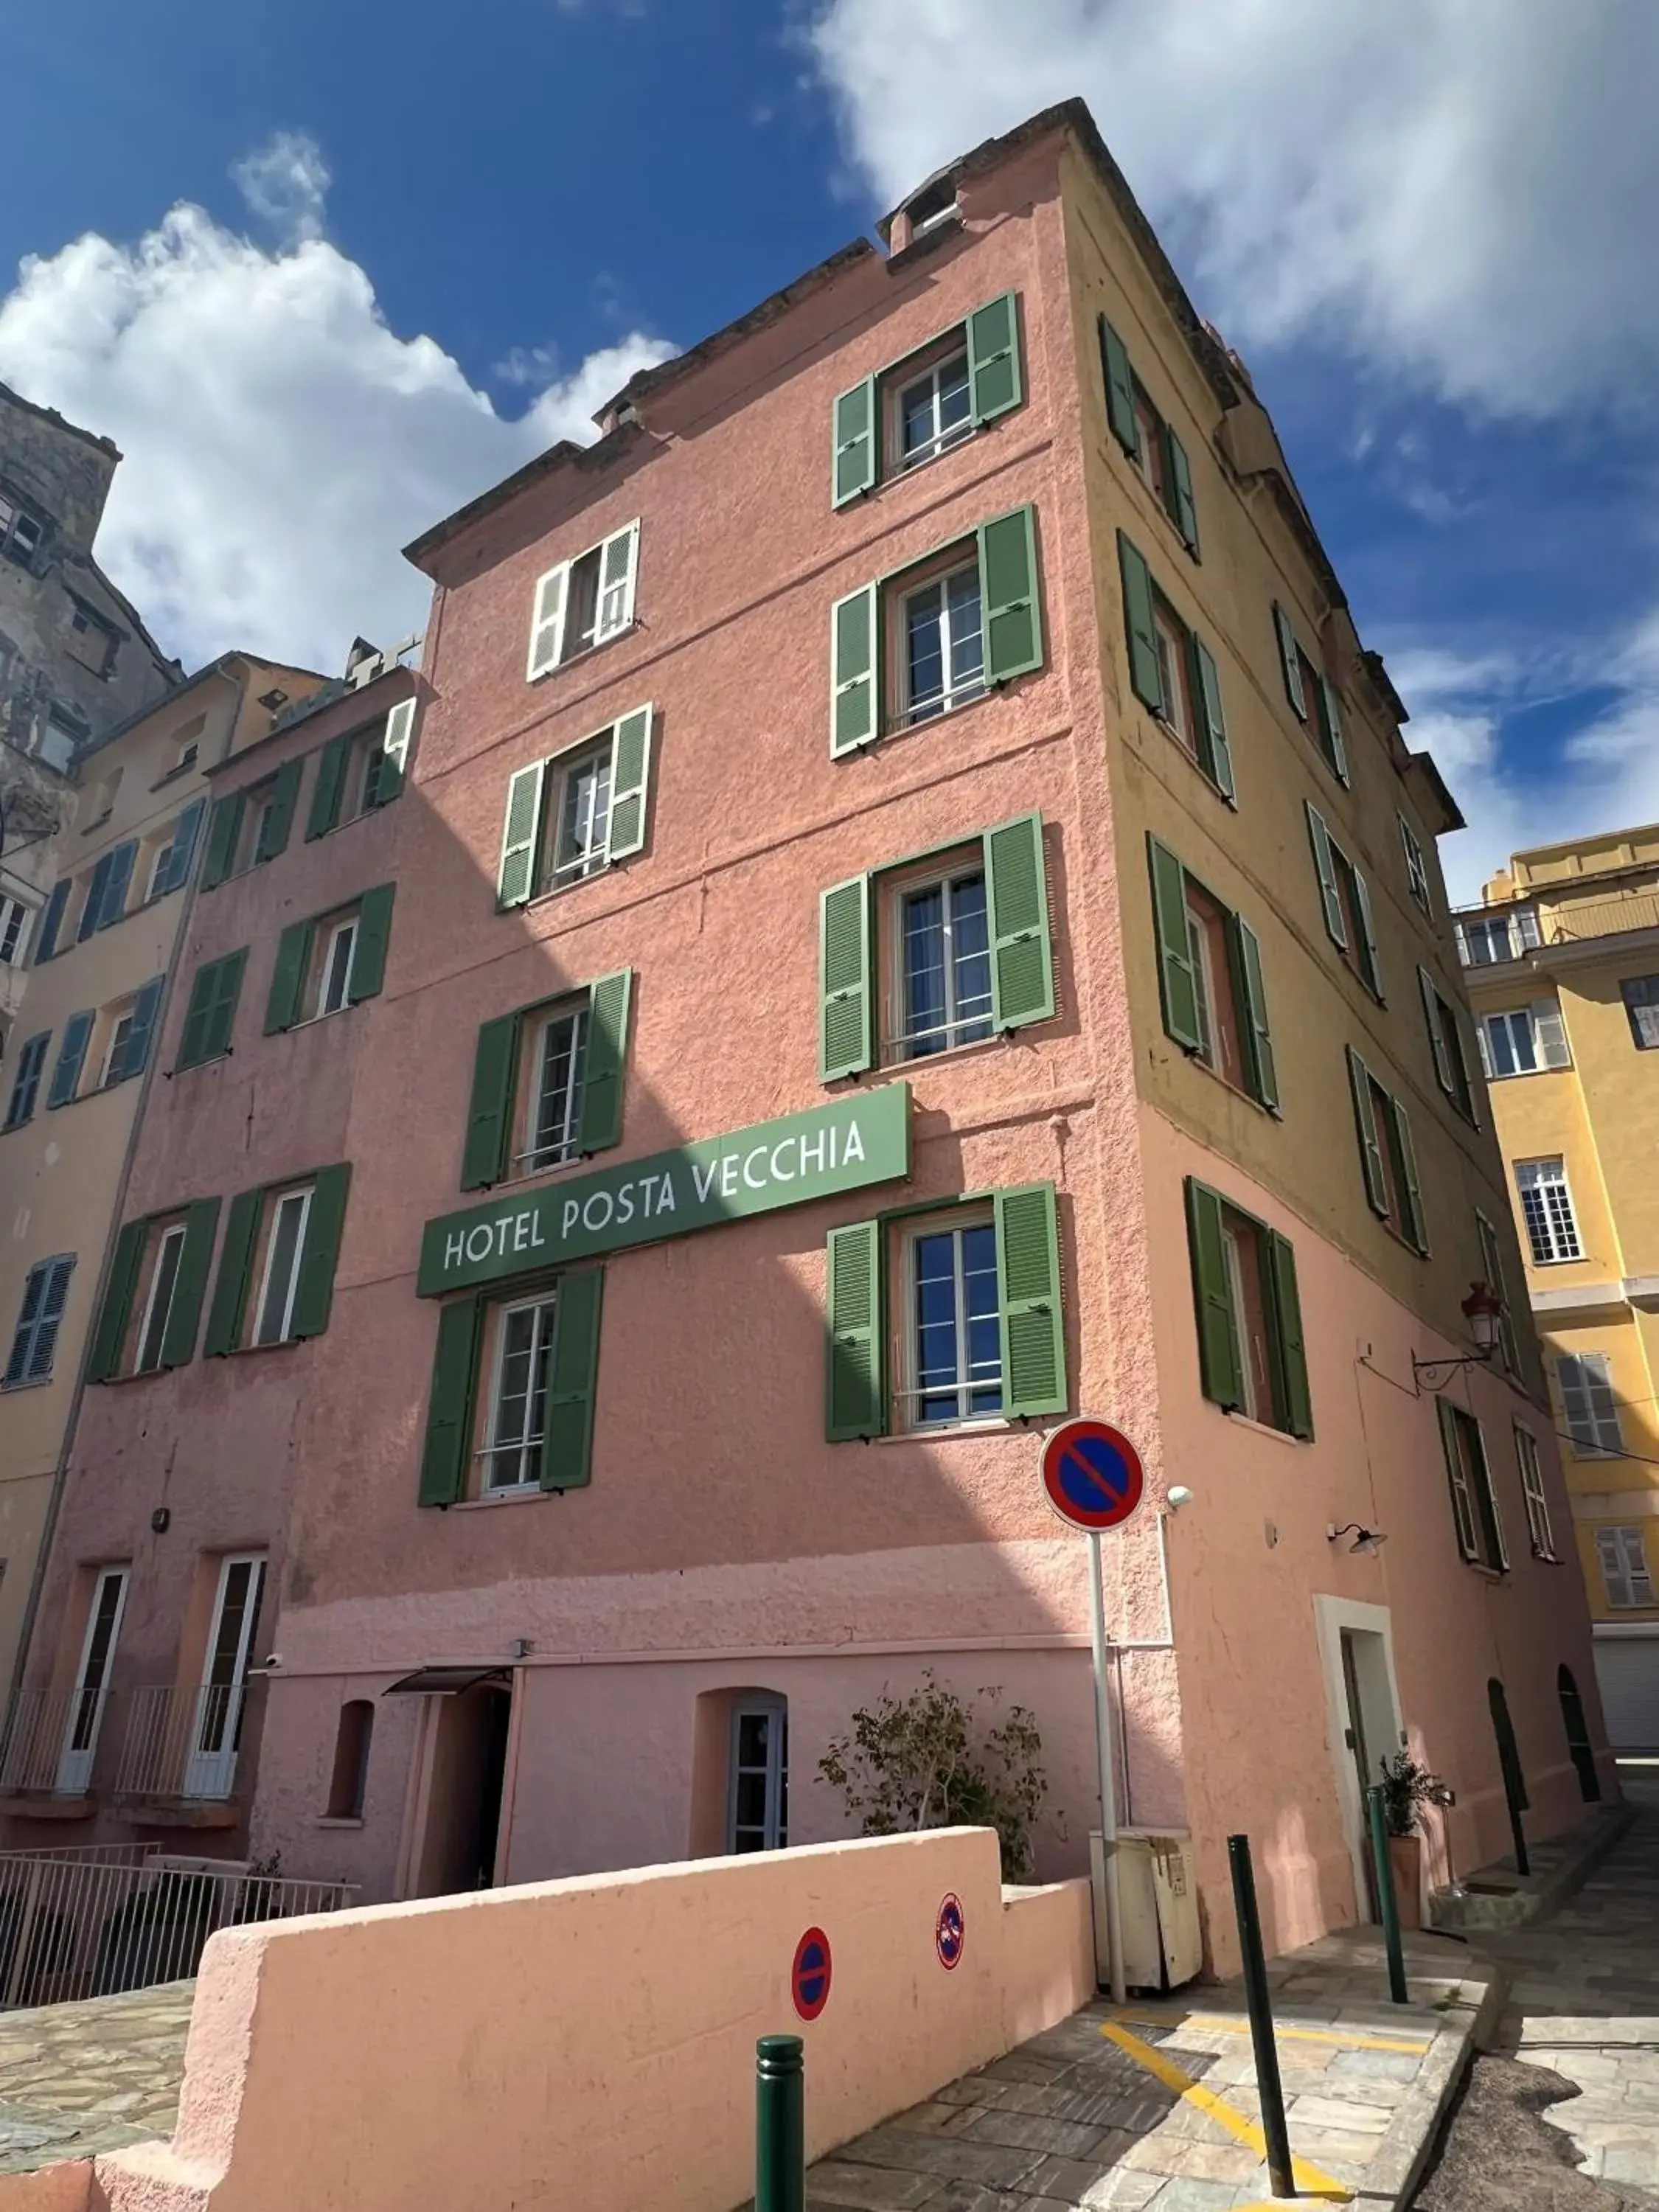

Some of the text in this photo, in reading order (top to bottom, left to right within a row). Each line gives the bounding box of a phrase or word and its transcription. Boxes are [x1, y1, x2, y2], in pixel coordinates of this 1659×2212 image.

[445, 1121, 866, 1269] HOTEL POSTA VECCHIA
